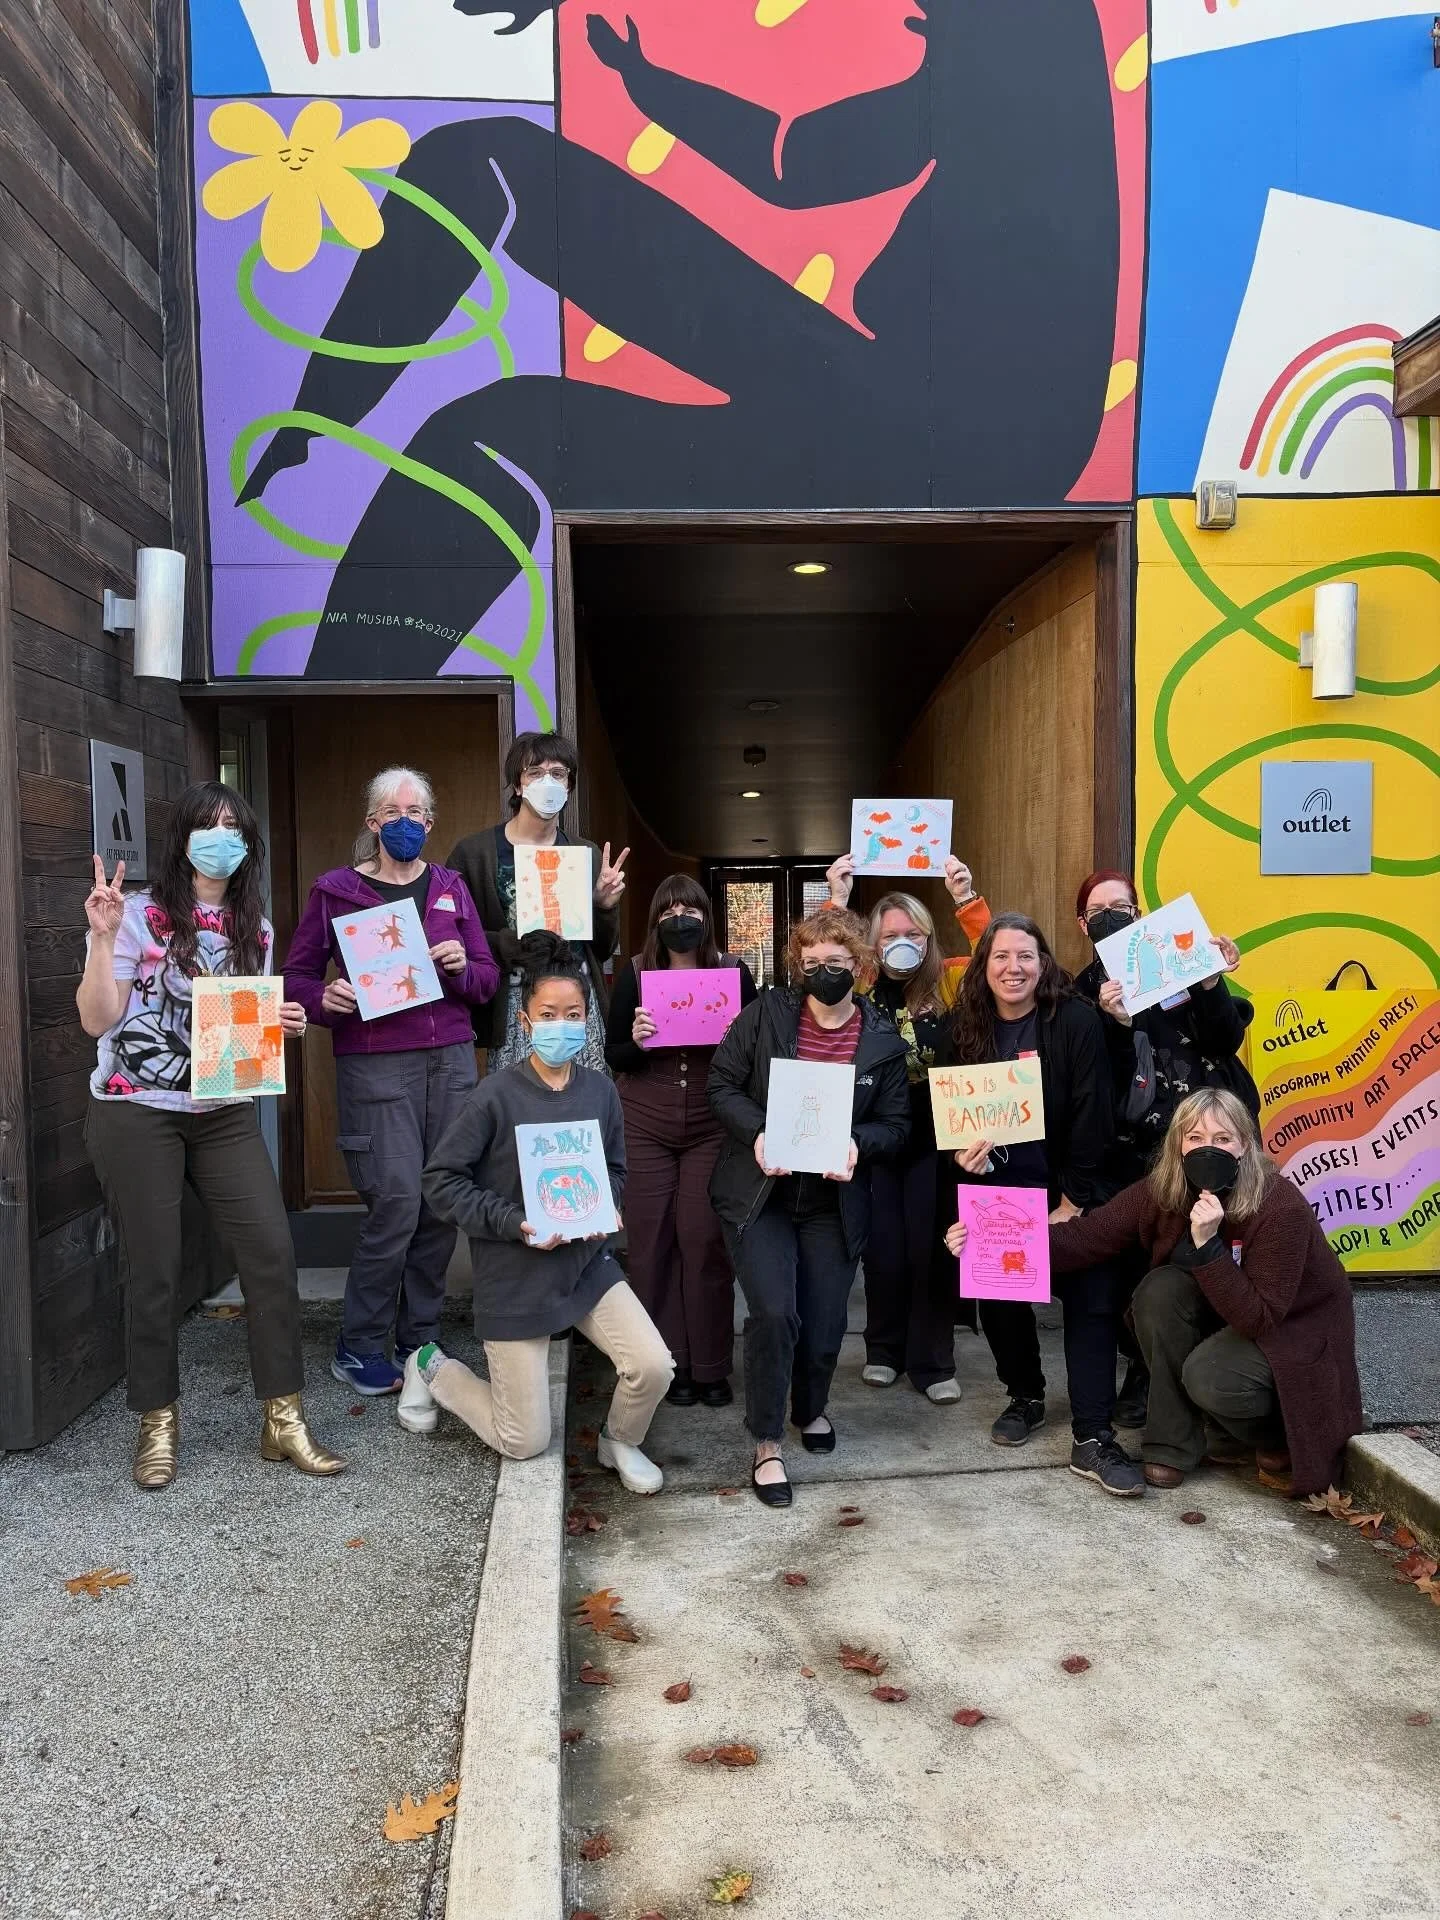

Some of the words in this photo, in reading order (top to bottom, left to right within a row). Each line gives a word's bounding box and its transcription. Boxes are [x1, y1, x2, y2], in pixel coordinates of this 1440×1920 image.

[325, 612, 348, 624] NIA
[356, 612, 401, 627] MUSIBA
[433, 624, 463, 643] 2021
[1282, 814, 1352, 833] outlet
[1262, 1017, 1329, 1052] outlet
[1263, 1070, 1331, 1107] RISOGRAPH
[1335, 1028, 1381, 1080] PRINTING
[1378, 995, 1419, 1032] PRESS!
[983, 1076, 997, 1093] is
[1267, 1100, 1355, 1155] COMMUNITY
[1363, 1074, 1391, 1108] ART
[1286, 1145, 1359, 1187] LASSES!
[1379, 1228, 1391, 1246] &
